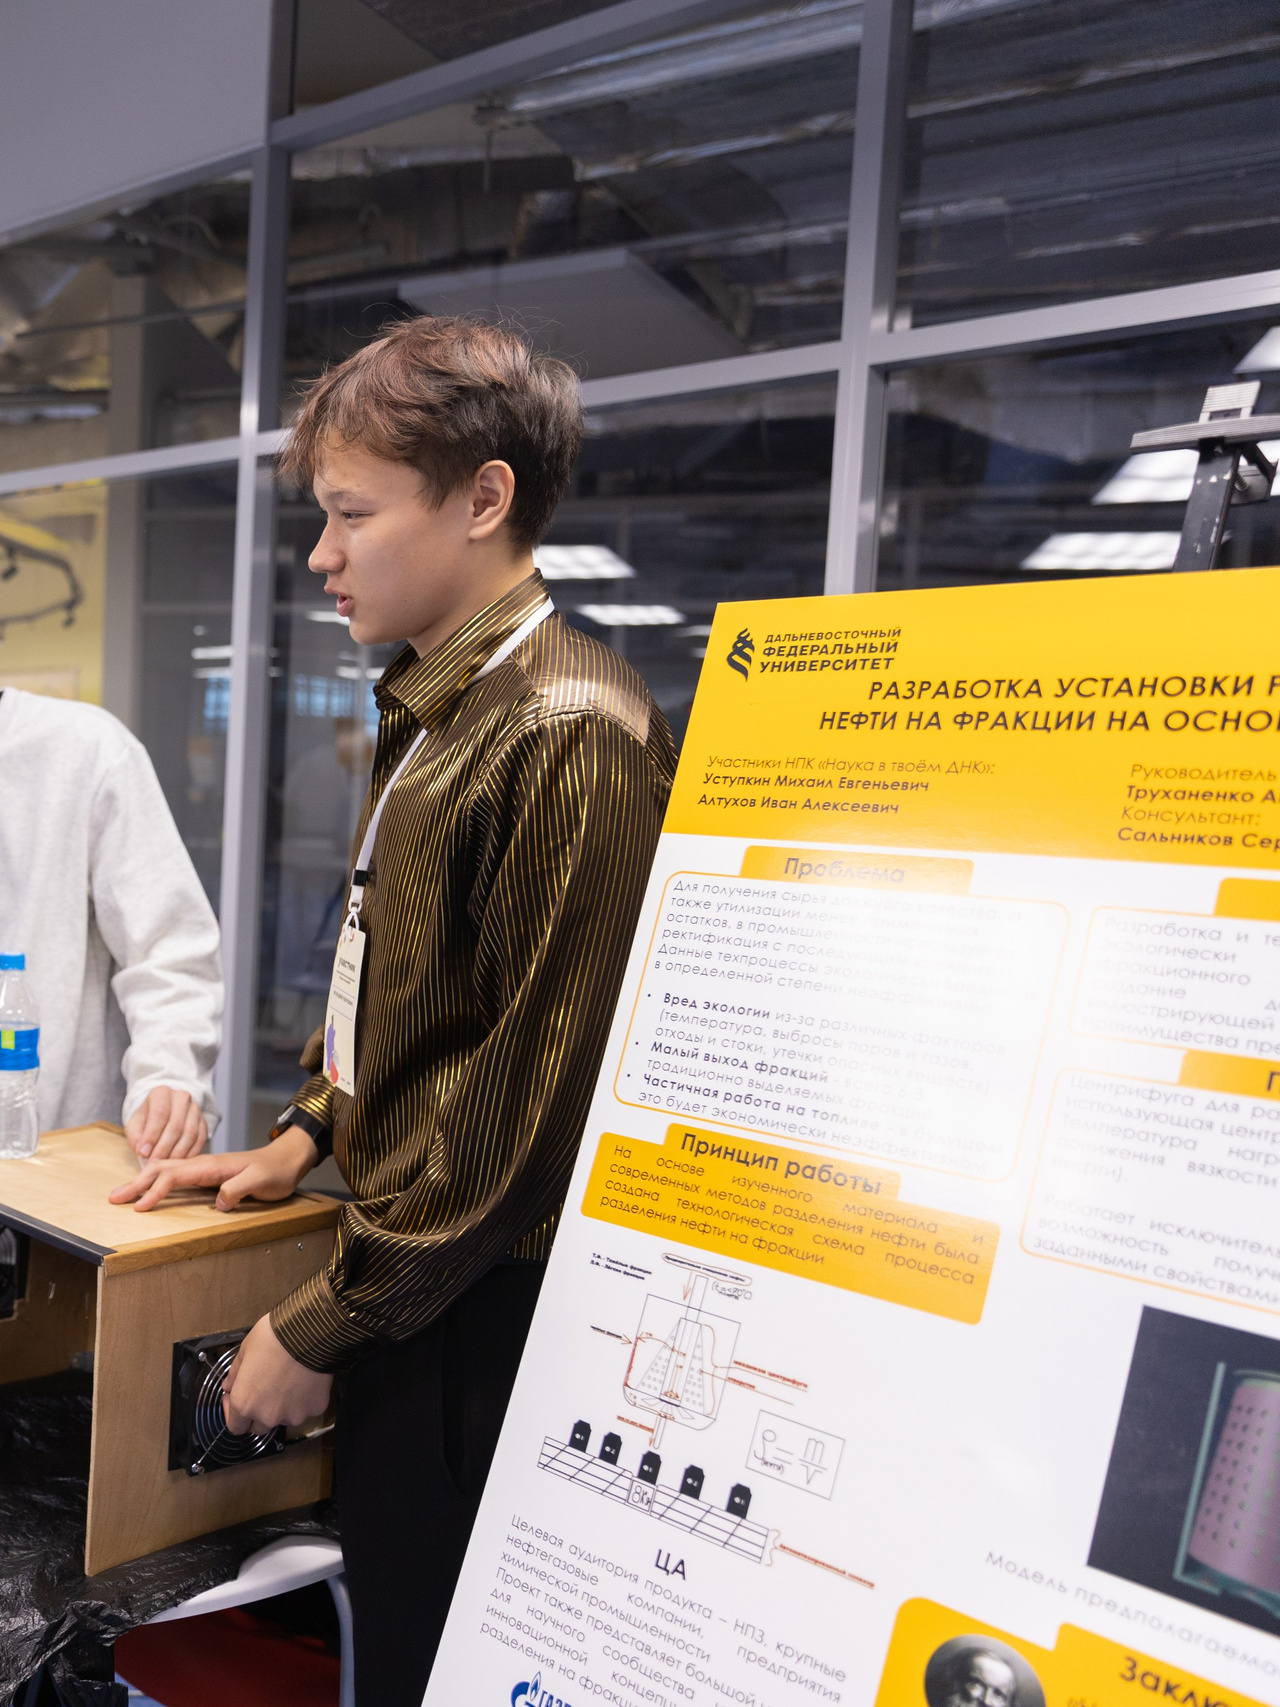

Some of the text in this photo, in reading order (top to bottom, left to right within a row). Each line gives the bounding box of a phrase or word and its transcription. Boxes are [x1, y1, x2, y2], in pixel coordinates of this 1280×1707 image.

[763, 639, 898, 657] ФЕДЕРАЛЬНЫЙ
[765, 626, 901, 643] ДАЛЬНЕВОСТОЧНЫЙ
[760, 658, 894, 673] УНИВЕРСИТЕТ
[869, 679, 1042, 700] РАЗРАБОТКА
[1054, 676, 1254, 698] УСТАНОВКИ
[820, 710, 1280, 733] НЕФТИ НА ФРАКЦИИ НА ОСНО
[703, 773, 929, 791] Уступкин Михаил Евгеньевич
[707, 756, 995, 775] Участники НПК «Наука в твоём ДНК»:
[1131, 764, 1277, 781] Руководитель
[698, 794, 899, 813] Алтухов Иван Алексеевич
[1127, 785, 1254, 802] Труханенко
[1122, 806, 1260, 825] Консультант:
[1118, 827, 1233, 846] Сальников
[784, 857, 905, 882] Проблема
[672, 898, 711, 909] также
[716, 902, 800, 917] утилизации
[804, 912, 855, 923] менее
[673, 881, 698, 891] Для
[703, 885, 776, 899] получения
[782, 892, 826, 904] сырья
[830, 896, 911, 912] должного
[667, 913, 729, 927] остатков,
[737, 921, 743, 929] в
[748, 922, 887, 944] промышленности
[1107, 919, 1249, 942] Разработка и
[662, 929, 907, 964] ректификация с последующим
[1102, 943, 1236, 962] экологически
[655, 961, 660, 969] в
[665, 962, 772, 983] определенной
[777, 977, 840, 992] степени
[658, 943, 938, 987] Данные техпроцессы экологически
[1099, 962, 1251, 985] фракционного
[1094, 983, 1186, 999] создание
[664, 993, 1005, 1056] Вред экологии из-за различных факторов
[1090, 1002, 1275, 1031] иллюстрирующей
[660, 1009, 765, 1036] (температура,
[772, 1029, 841, 1048] выбросы
[848, 1041, 901, 1058] паров
[905, 1051, 916, 1060] и
[1085, 1021, 1238, 1048] преимущества
[651, 1042, 698, 1059] Малый
[704, 1053, 748, 1069] выход
[755, 1060, 827, 1081] фракций
[845, 1078, 892, 1095] всего
[655, 1028, 990, 1096] отходы и стоки, утечки опасных веществ)
[644, 1074, 718, 1098] Частичная
[723, 1092, 780, 1110] работа
[786, 1104, 805, 1116] на
[812, 1109, 878, 1128] топливе
[648, 1060, 931, 1120] традиционно выделяемых фракций
[1071, 1079, 1239, 1113] Центрифуга для
[639, 1092, 661, 1104] это
[666, 1096, 707, 1113] будет
[711, 1107, 826, 1138] экономически
[1068, 1100, 1214, 1131] использующая
[681, 1133, 880, 1194] Принцип работы
[1060, 1141, 1277, 1187] понижения вязкости
[614, 1145, 984, 1245] На основе изученного материала и
[1045, 1194, 1135, 1226] Работает
[600, 1197, 824, 1264] разделения нефти на фракции
[610, 1164, 979, 1264] современных методов разделения нефти была
[606, 1180, 974, 1284] создана технологическая схема процесса
[1040, 1220, 1169, 1256] возможность
[1034, 1238, 1147, 1273] заданными
[655, 1549, 685, 1580] ЦА
[986, 1551, 1067, 1593] Модель
[501, 1552, 710, 1662] химической промышленности
[512, 1514, 846, 1682] Целевая аудитория продукта НПЗ, крупные
[486, 1605, 587, 1665] инновационной
[506, 1535, 840, 1703] нефтегазовые компании, предприятия
[480, 1623, 575, 1680] разделения на
[490, 1588, 695, 1700] для научного сообщества
[496, 1567, 541, 1598] Проект
[545, 1593, 582, 1619] также
[586, 1615, 681, 1669] представляет
[685, 1663, 753, 1707] большой
